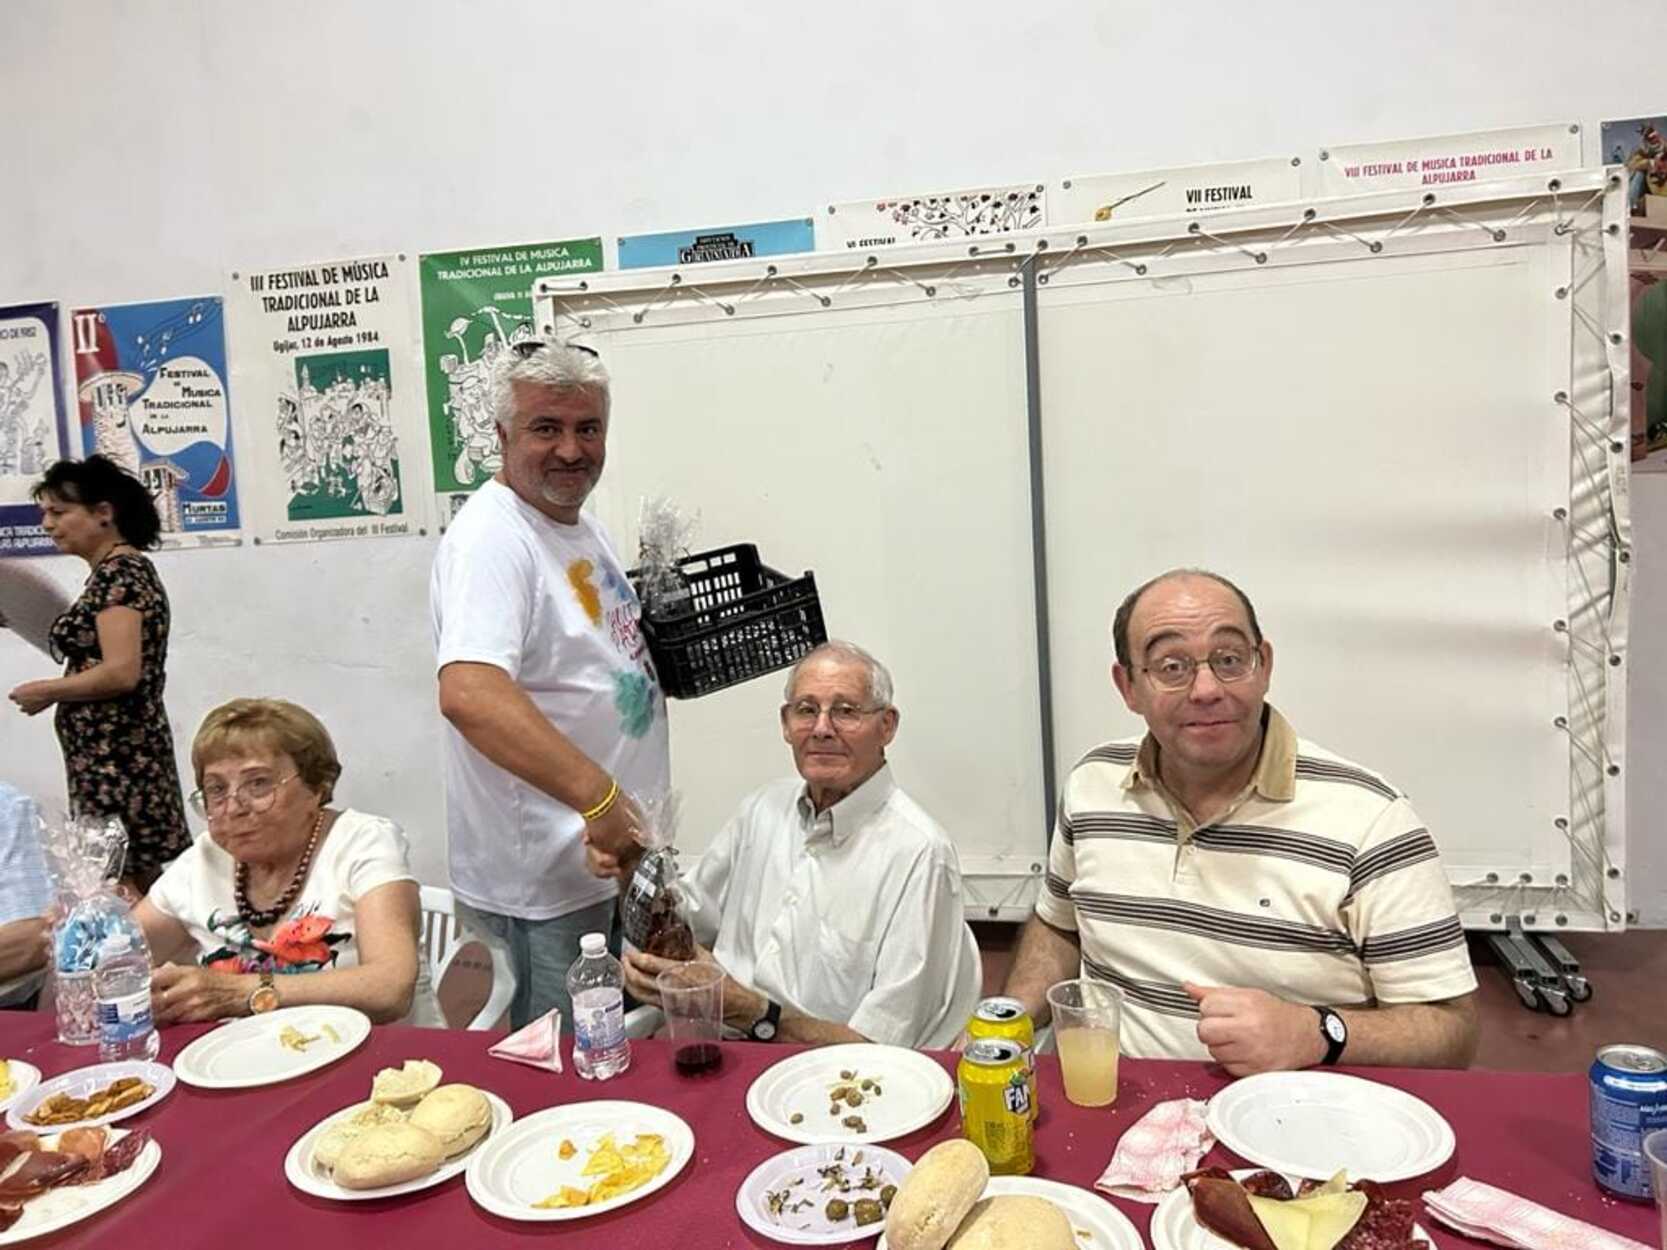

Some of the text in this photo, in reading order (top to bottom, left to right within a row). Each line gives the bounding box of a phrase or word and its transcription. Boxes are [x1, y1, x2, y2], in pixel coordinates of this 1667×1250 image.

[1345, 148, 1552, 177] VIII FESTIVAL DE MUSICA TRADICIONAL DE LA
[1422, 170, 1476, 184] ALPUJARRA
[1186, 184, 1252, 203] VII FESTIVAL
[460, 247, 569, 266] IV FESTIVAL DE MUSICA
[251, 261, 389, 291] III FESTIVAL DE MÚSICA
[437, 258, 592, 280] TRADICIONAL DE LA ALPUJARRA
[262, 286, 379, 313] TRADICIONAL DE LA
[288, 311, 357, 332] ALPUJARRA
[301, 337, 312, 348] 12
[315, 336, 325, 346] de
[327, 335, 354, 348] Agosto
[356, 331, 379, 343] 1984
